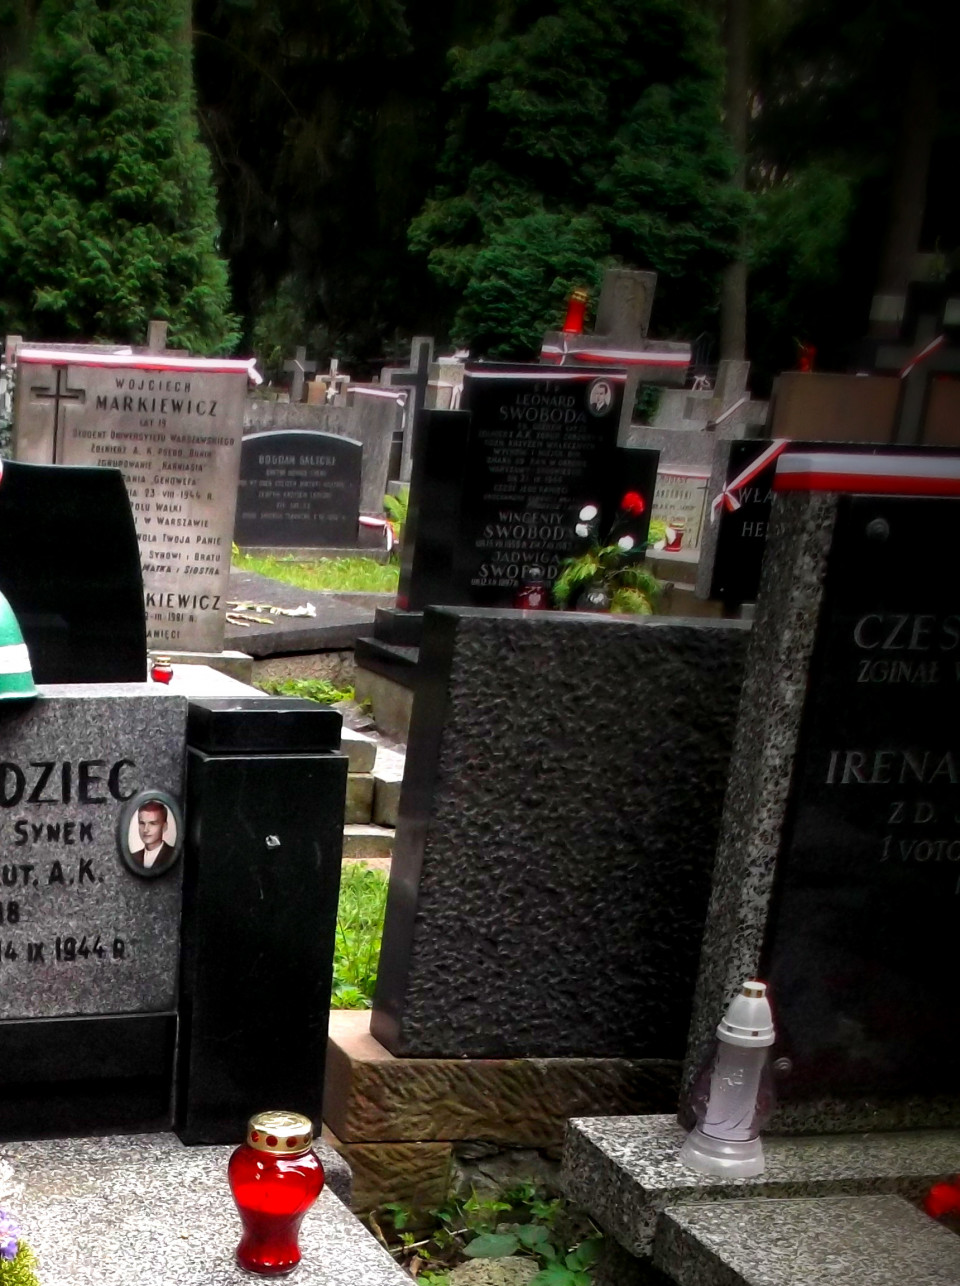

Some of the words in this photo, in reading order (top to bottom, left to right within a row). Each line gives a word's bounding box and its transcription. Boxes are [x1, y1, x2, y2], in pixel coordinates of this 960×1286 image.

[115, 378, 192, 393] WOJCIECH
[95, 395, 218, 417] MARKIEWICZ
[515, 394, 576, 407] LEONARD
[499, 405, 587, 424] SWOBODA
[157, 517, 209, 528] WARSZAWIE
[162, 533, 191, 544] TWOJA
[196, 535, 222, 546] PANIE
[194, 552, 221, 563] BRATU
[491, 550, 561, 564] JADWIGA
[183, 565, 220, 576] SIOSTRA
[146, 593, 221, 611] KIEWICZ
[146, 629, 181, 641] AMIĘCI
[14, 819, 95, 847] SYNEK
[27, 941, 45, 964] IX
[54, 934, 105, 962] 1944
